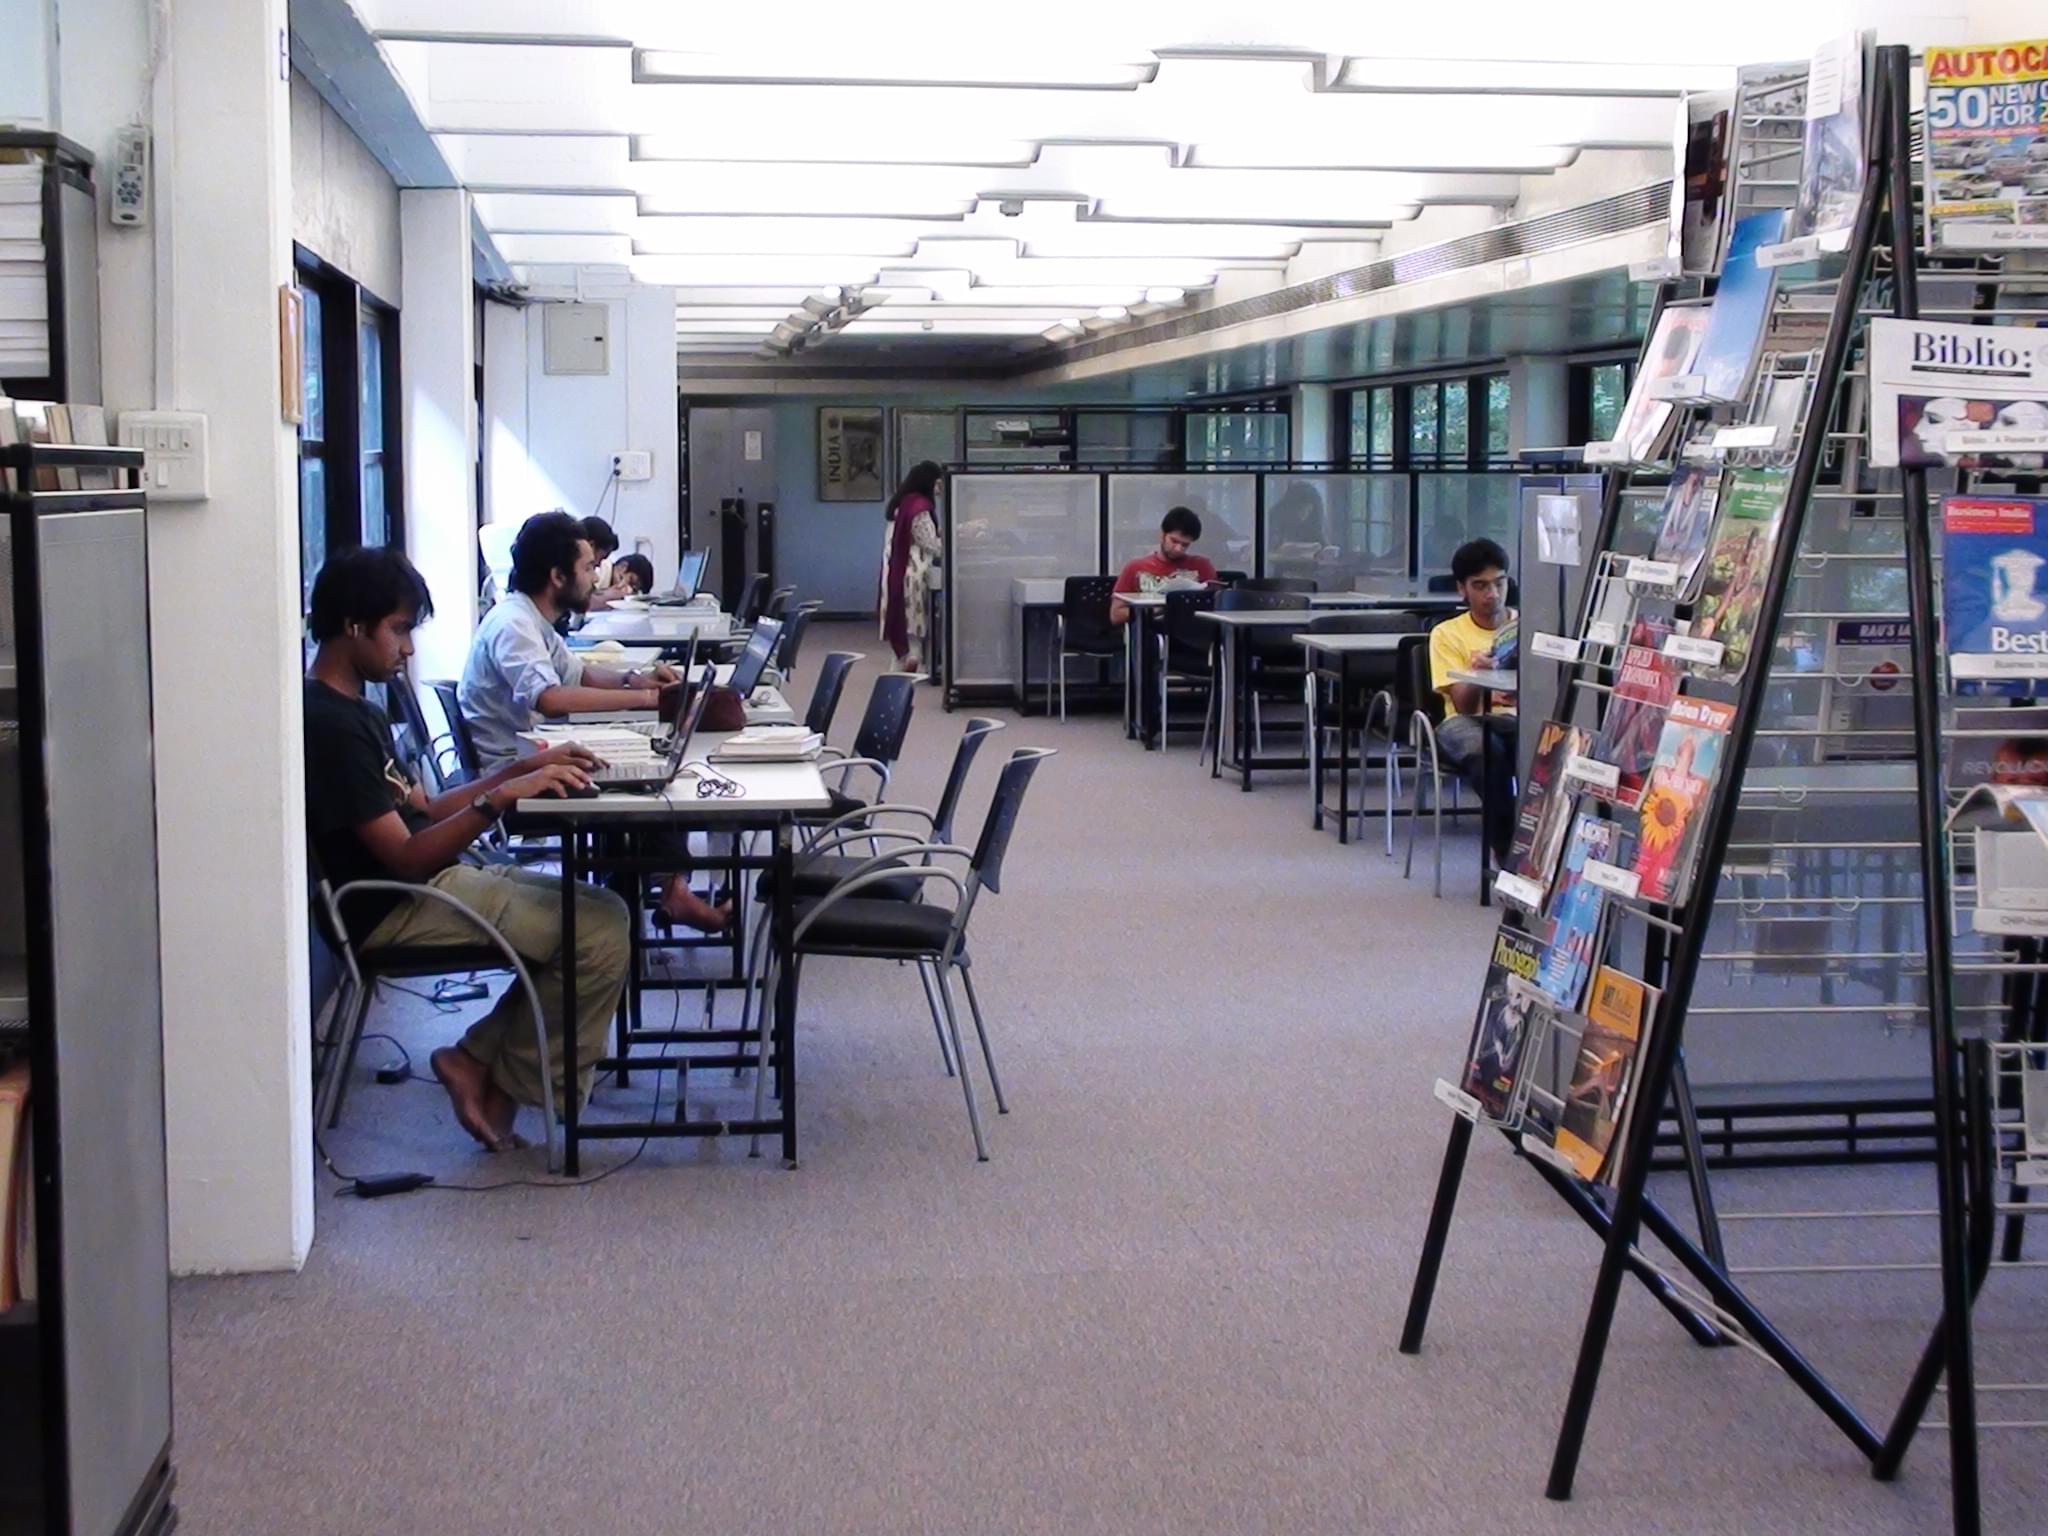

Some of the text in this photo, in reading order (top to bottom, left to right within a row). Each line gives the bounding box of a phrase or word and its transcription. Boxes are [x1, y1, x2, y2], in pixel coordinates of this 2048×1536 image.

[1928, 87, 1988, 128] 50
[1989, 82, 2037, 105] NEW
[1990, 105, 2034, 126] FOR
[1912, 332, 2032, 368] Biblio:
[828, 434, 841, 482] INDIA
[1991, 627, 2048, 653] Best
